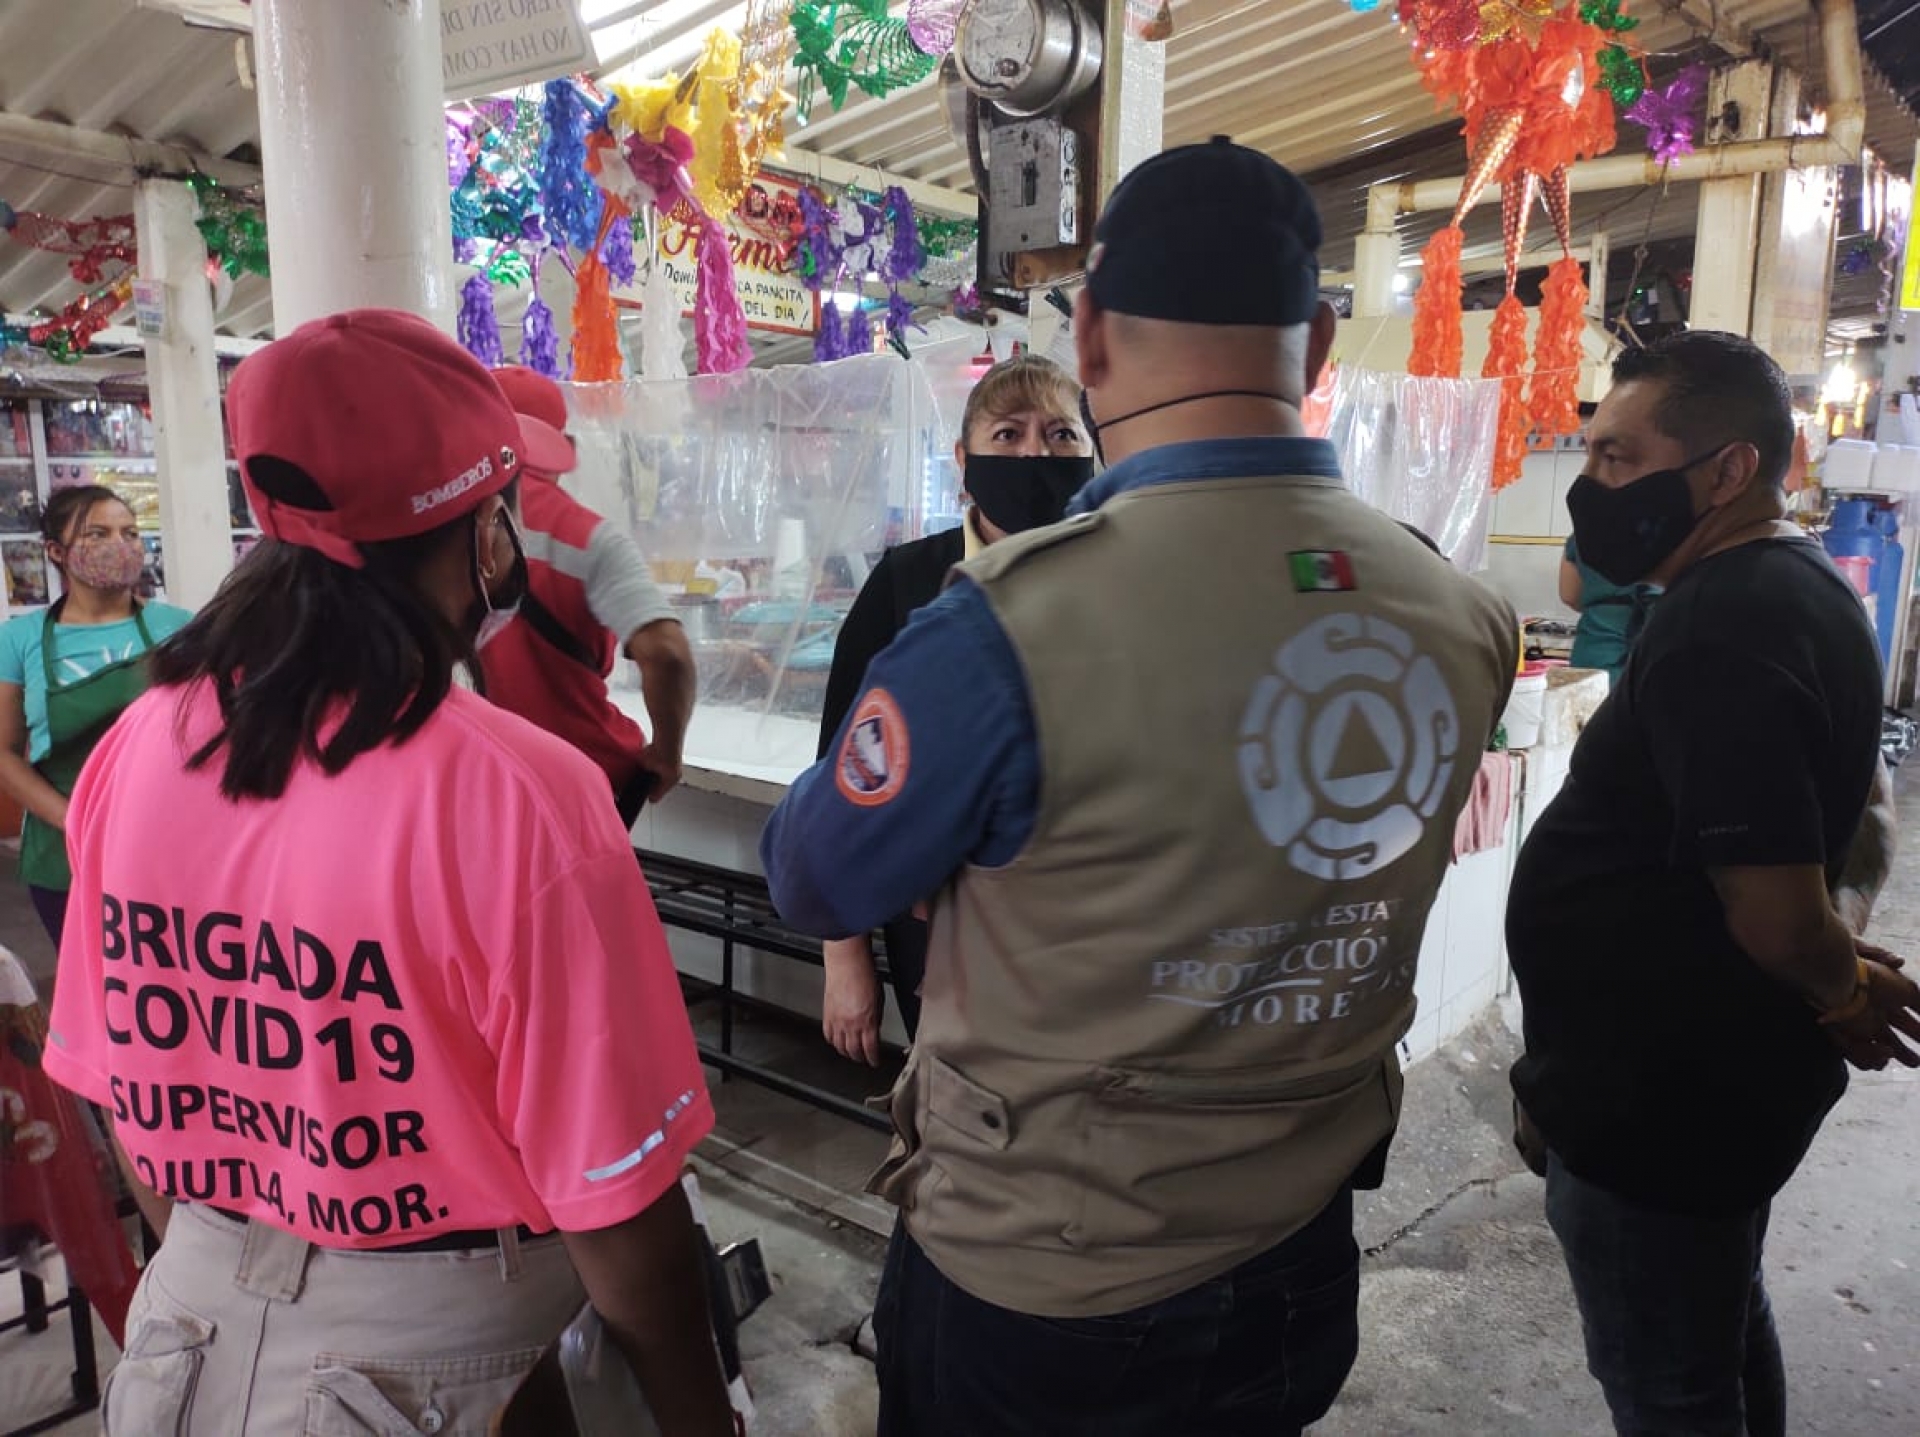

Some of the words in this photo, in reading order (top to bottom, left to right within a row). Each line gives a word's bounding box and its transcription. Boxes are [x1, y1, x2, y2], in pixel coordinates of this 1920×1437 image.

[744, 300, 768, 318] DEL
[411, 455, 492, 514] BOMBEROS
[102, 893, 403, 1010] BRIGADA
[110, 1075, 428, 1170] SUPERVISOR
[307, 1183, 449, 1236] MOR.
